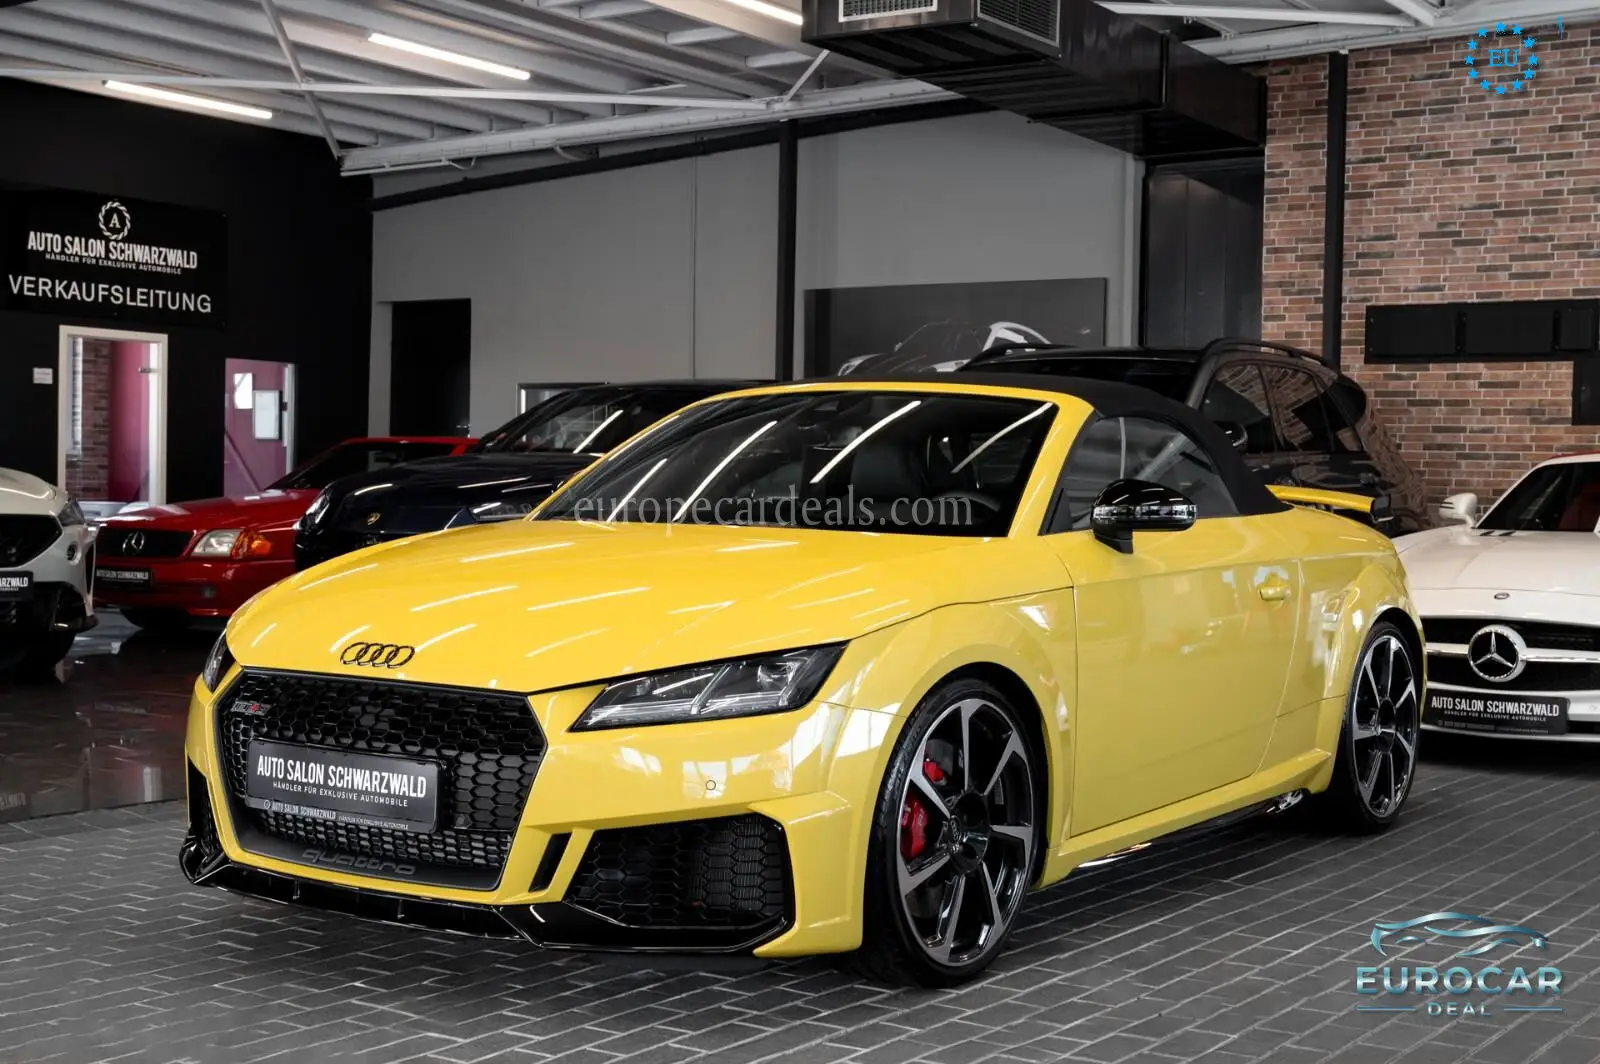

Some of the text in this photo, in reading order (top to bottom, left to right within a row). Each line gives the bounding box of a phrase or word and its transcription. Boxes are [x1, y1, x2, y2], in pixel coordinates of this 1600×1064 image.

[109, 213, 121, 228] A
[27, 231, 198, 269] AUTO SALON SCHWARZWALD
[98, 259, 137, 270] EXKLUSIVE
[138, 263, 182, 275] AUTOMOBILE
[8, 274, 212, 313] VERKAUFSLEITUNG
[0, 576, 29, 587] RZWALD
[1431, 696, 1560, 717] AUTO SALON SCHWARZWALD
[257, 755, 427, 799] AUTO SALON SCHWARZWALD
[273, 780, 409, 807] HÄNDLER FÜR EXKLUSIVE AUTOMOBILE
[301, 849, 416, 876] quattro
